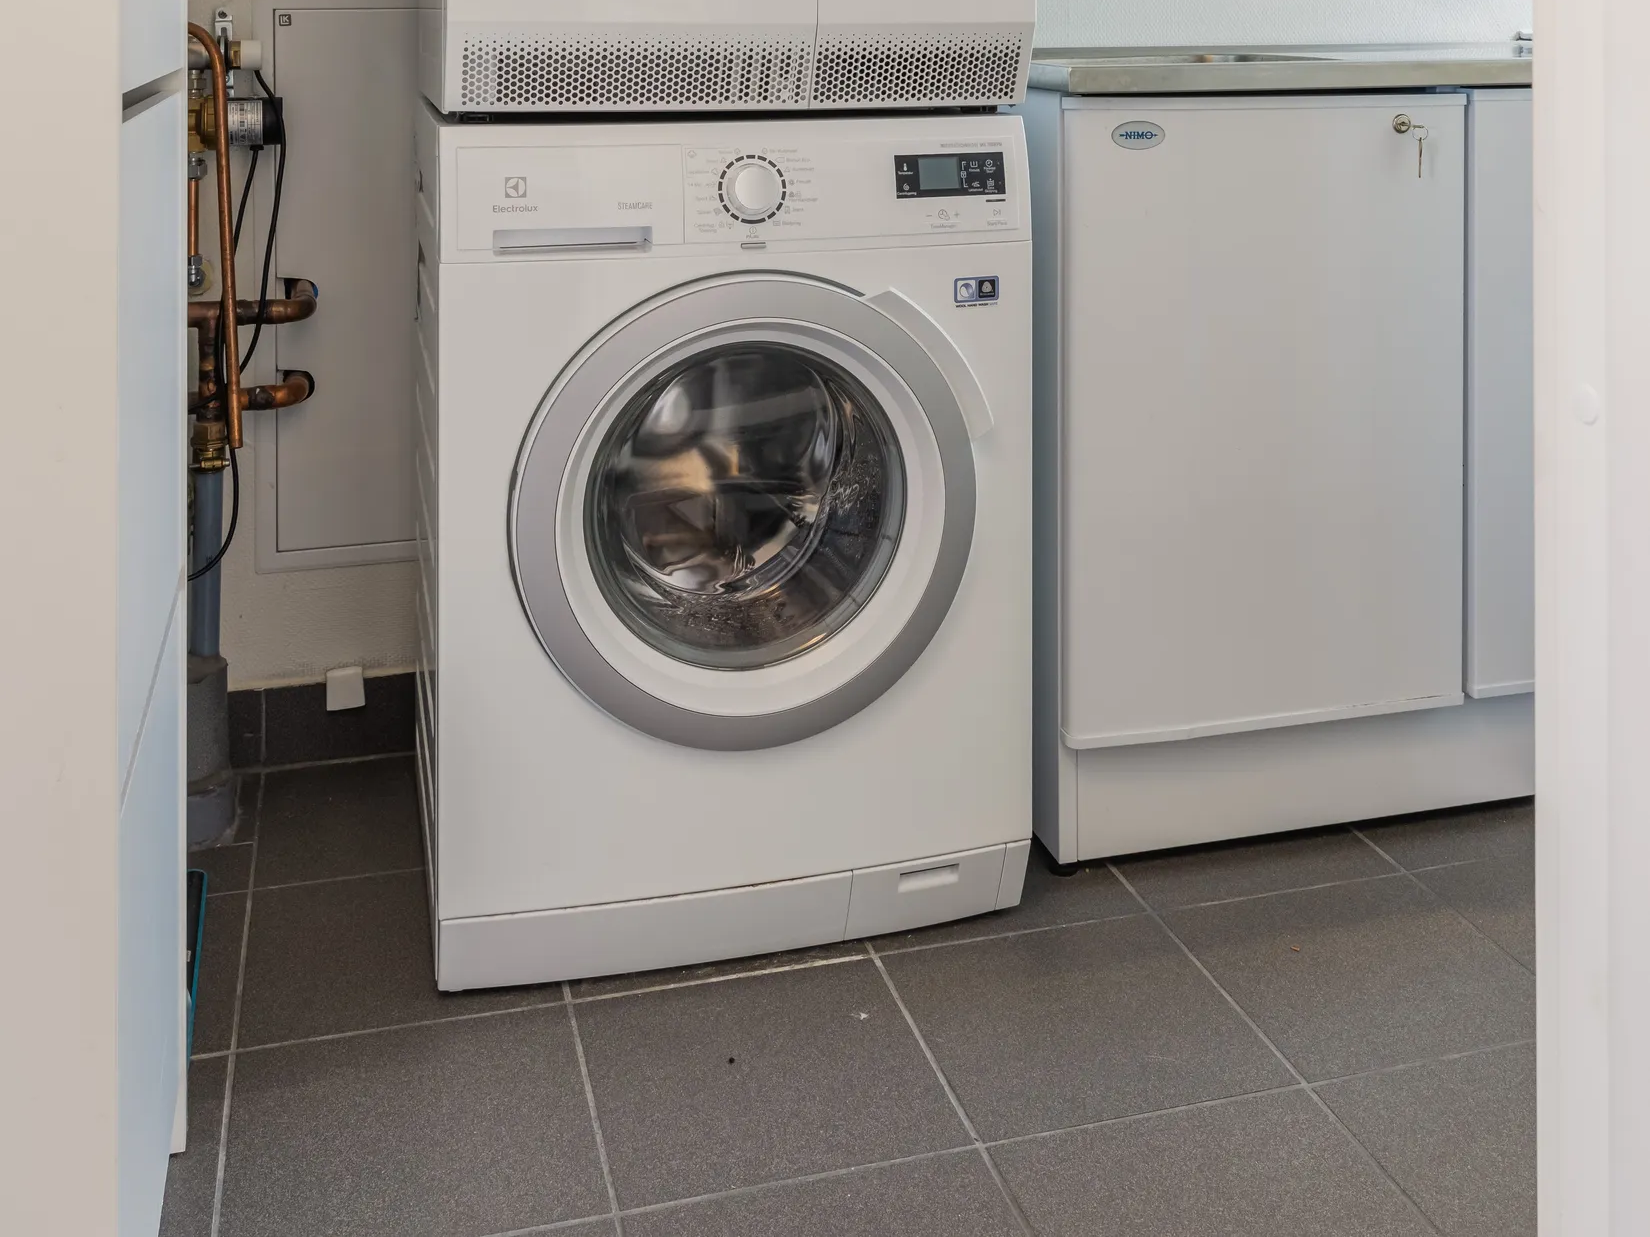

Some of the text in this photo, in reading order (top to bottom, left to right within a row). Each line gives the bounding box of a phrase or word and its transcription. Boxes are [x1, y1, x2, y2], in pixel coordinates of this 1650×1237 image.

[1124, 130, 1154, 140] NIMO
[492, 204, 538, 213] Electrolux
[617, 201, 653, 211] STEAMCARE
